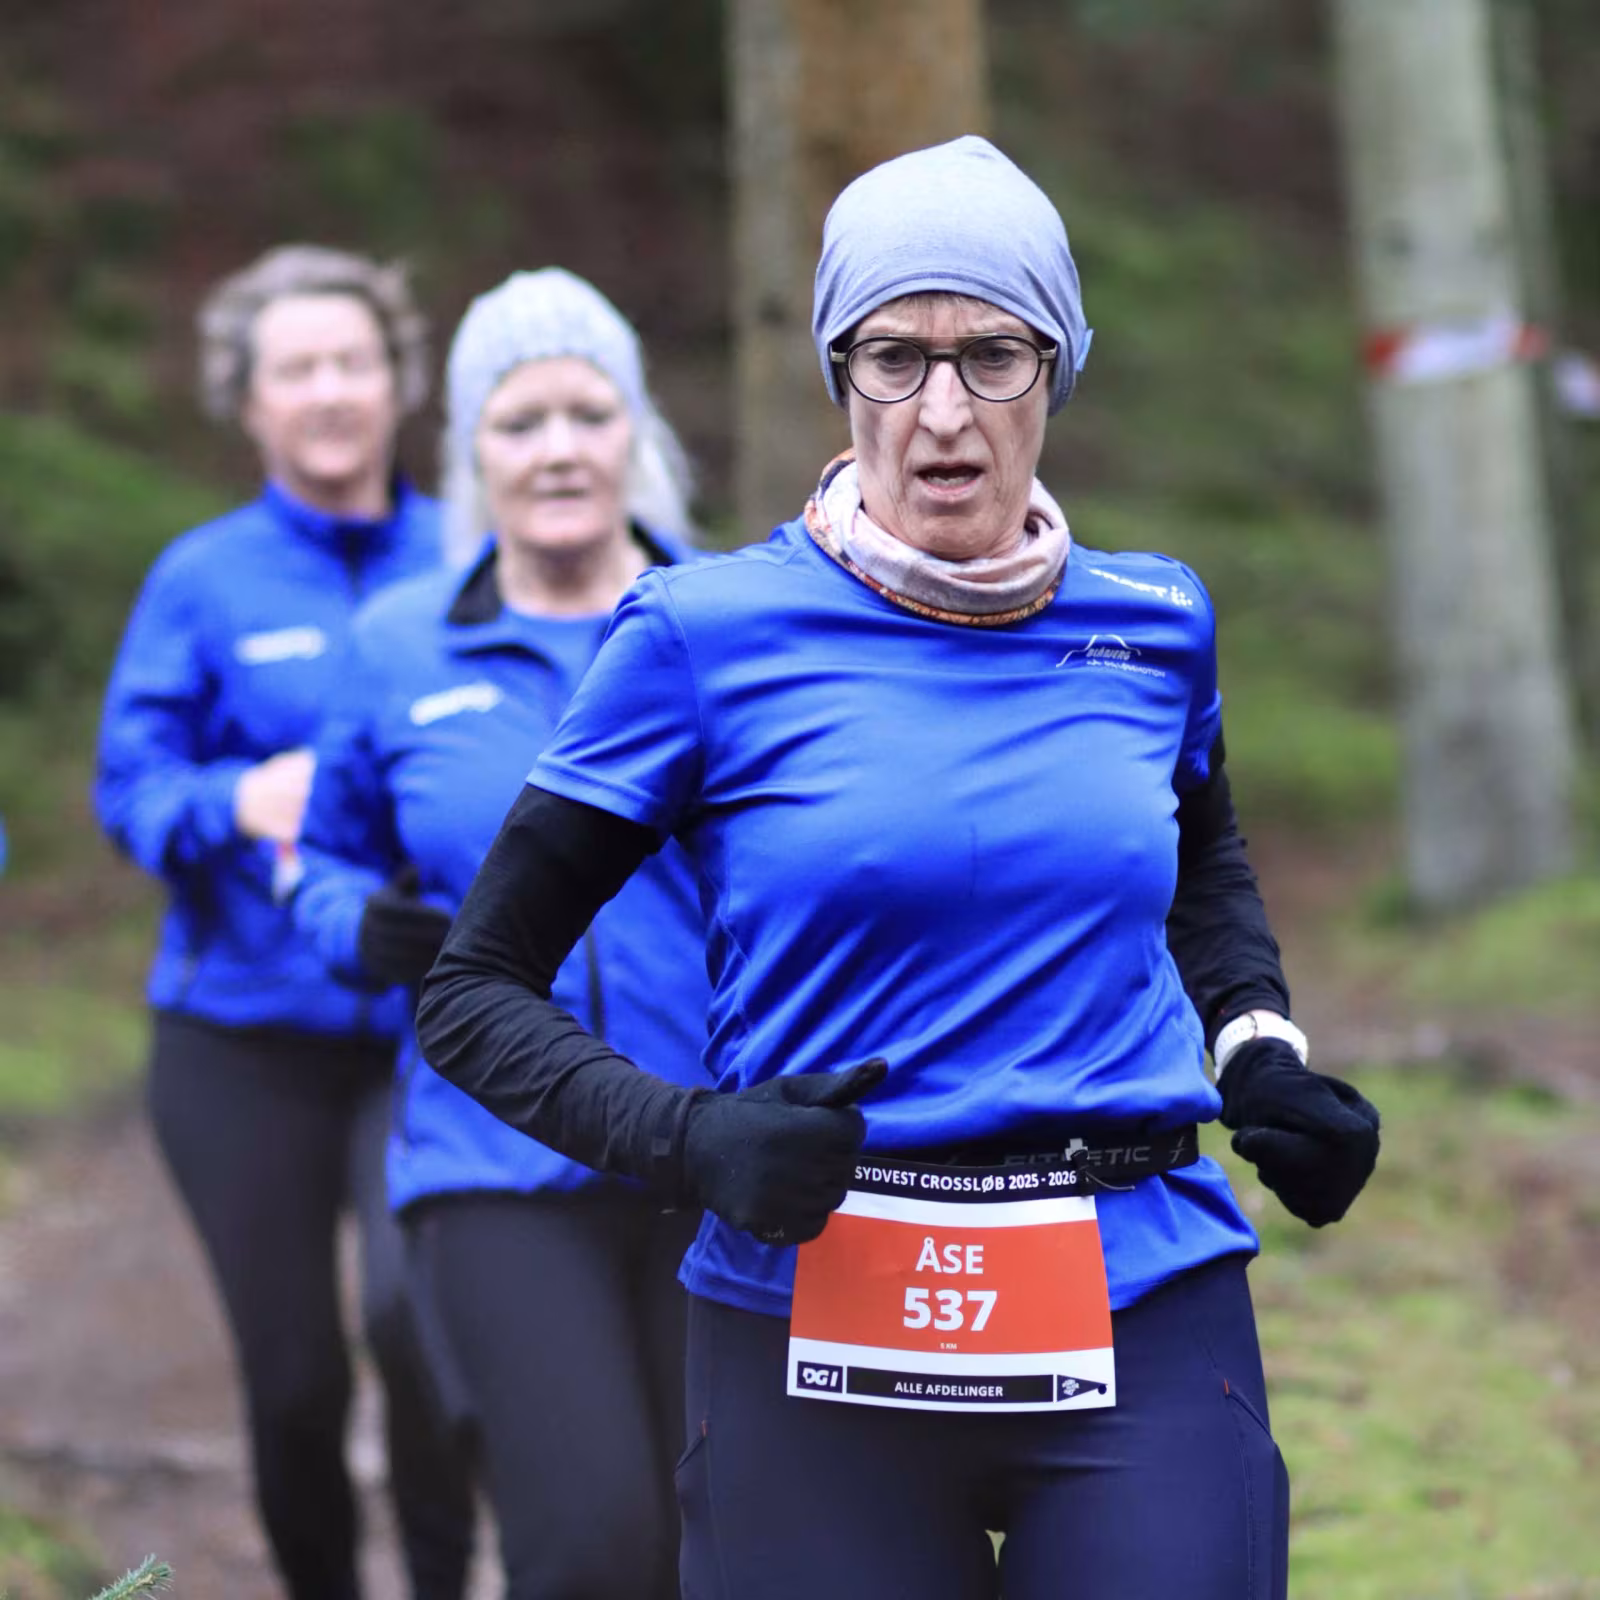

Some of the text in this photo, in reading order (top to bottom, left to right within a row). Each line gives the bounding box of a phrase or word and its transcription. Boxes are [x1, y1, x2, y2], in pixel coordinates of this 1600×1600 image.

[1004, 1146, 1152, 1167] FITETIC
[855, 1165, 918, 1187] SYDVEST
[920, 1173, 1005, 1193] CROSSLØB
[1008, 1173, 1039, 1190] 2025
[1048, 1170, 1077, 1187] 2026
[915, 1236, 984, 1275] ÅSE
[903, 1286, 998, 1332] 537
[802, 1367, 838, 1388] DGI
[894, 1381, 1004, 1397] ALLE AFDELINGER
